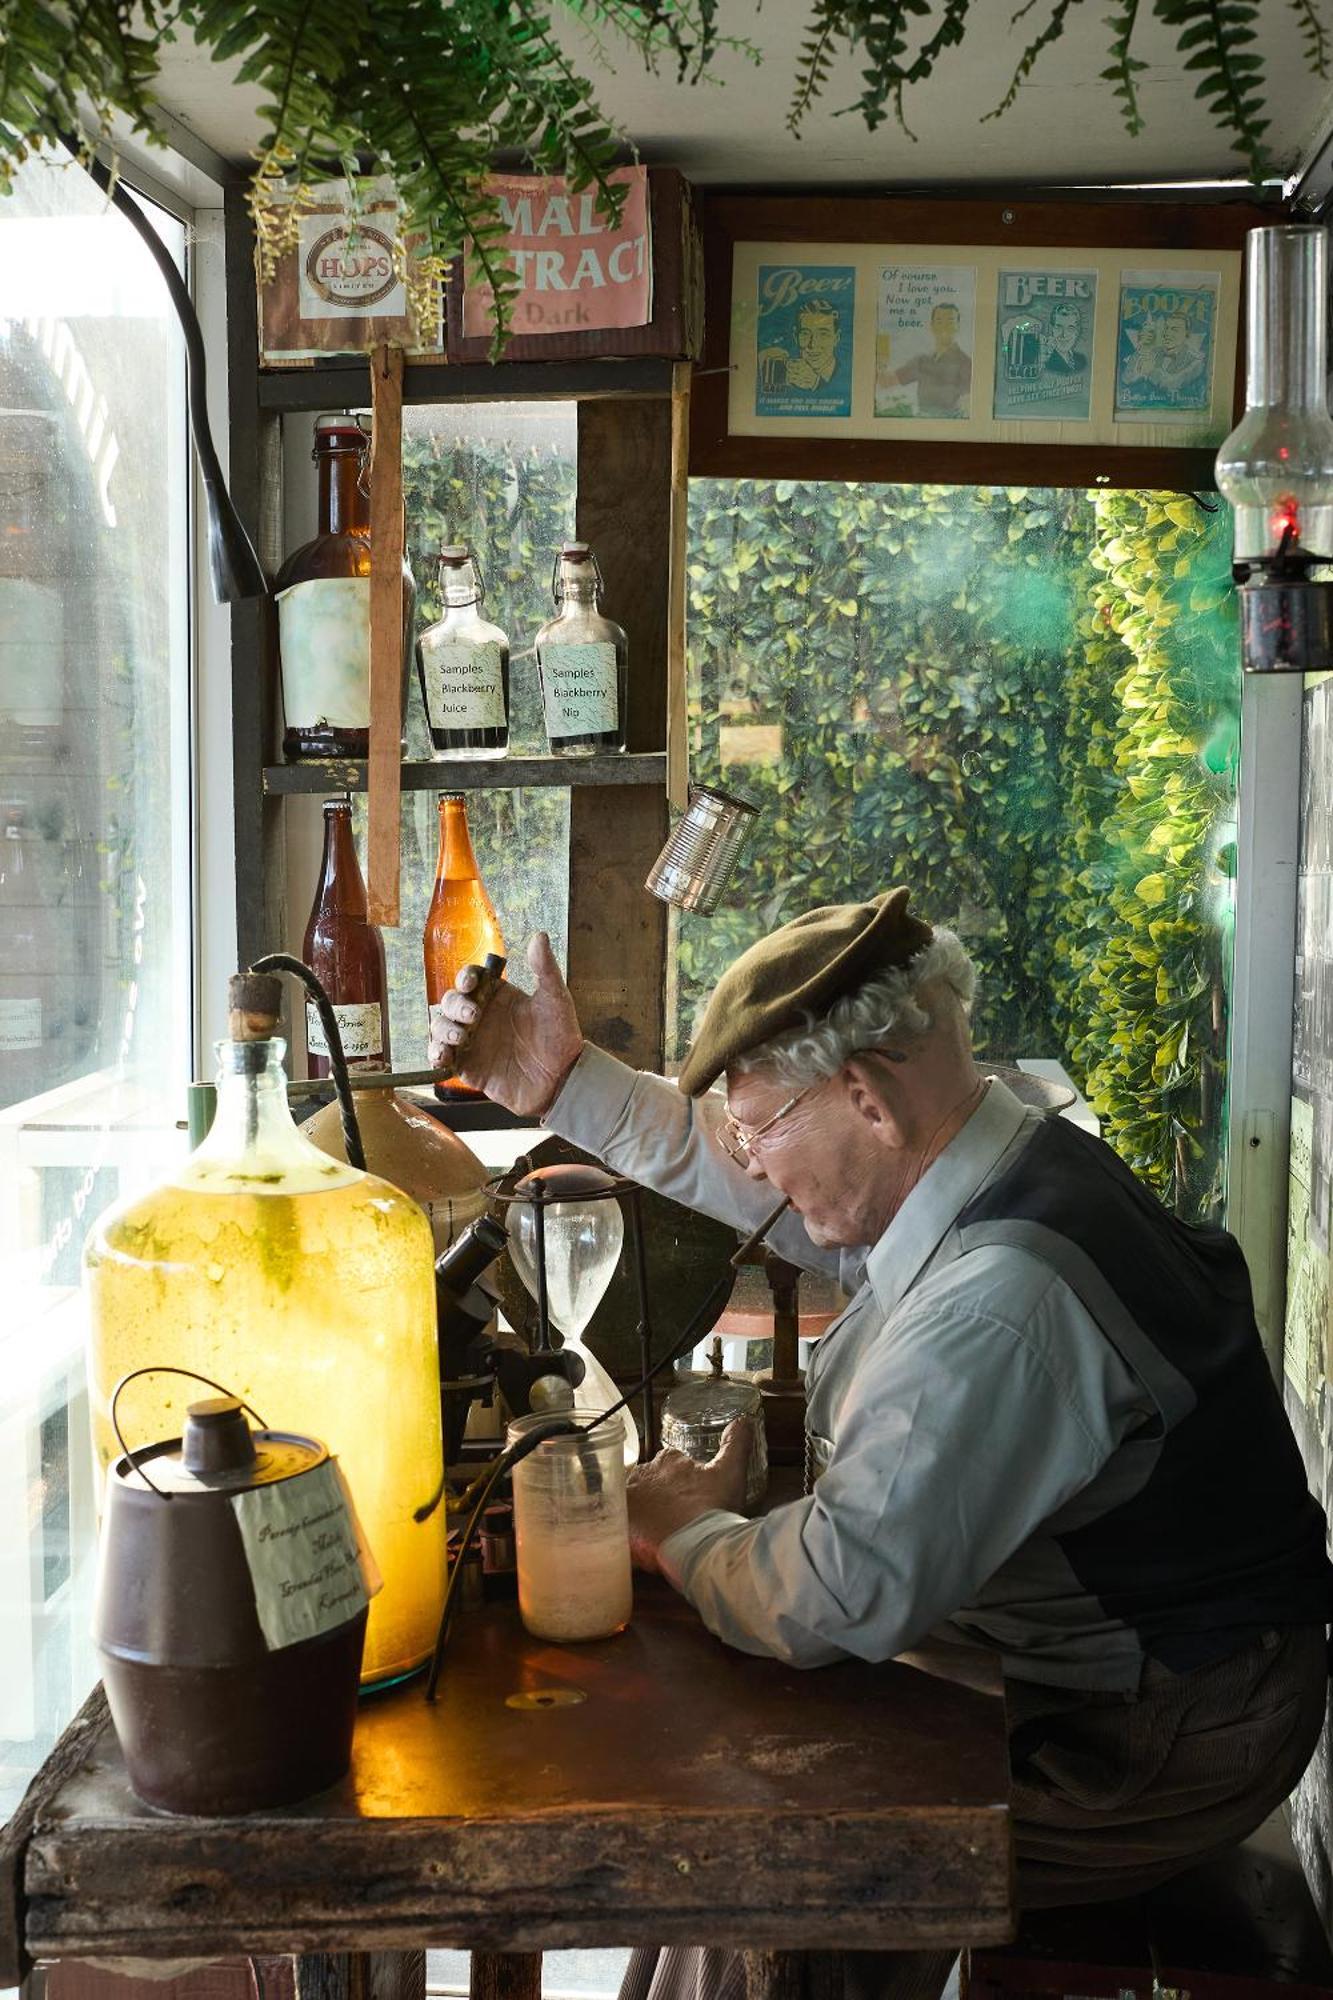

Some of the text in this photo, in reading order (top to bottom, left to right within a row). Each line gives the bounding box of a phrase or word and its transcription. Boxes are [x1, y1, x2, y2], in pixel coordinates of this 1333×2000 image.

[499, 194, 615, 237] MAL
[320, 257, 389, 278] HOPS
[509, 234, 646, 290] TRACT
[882, 269, 898, 281] Of
[898, 282, 903, 293] I
[907, 282, 929, 293] love
[1005, 275, 1090, 306] BEER
[886, 295, 911, 305] Now
[525, 302, 590, 326] Dark
[439, 664, 484, 676] Samples
[552, 668, 595, 680] Samples
[441, 683, 496, 695] Blackberry
[553, 687, 607, 699] Blackberry
[442, 702, 468, 714] Juice
